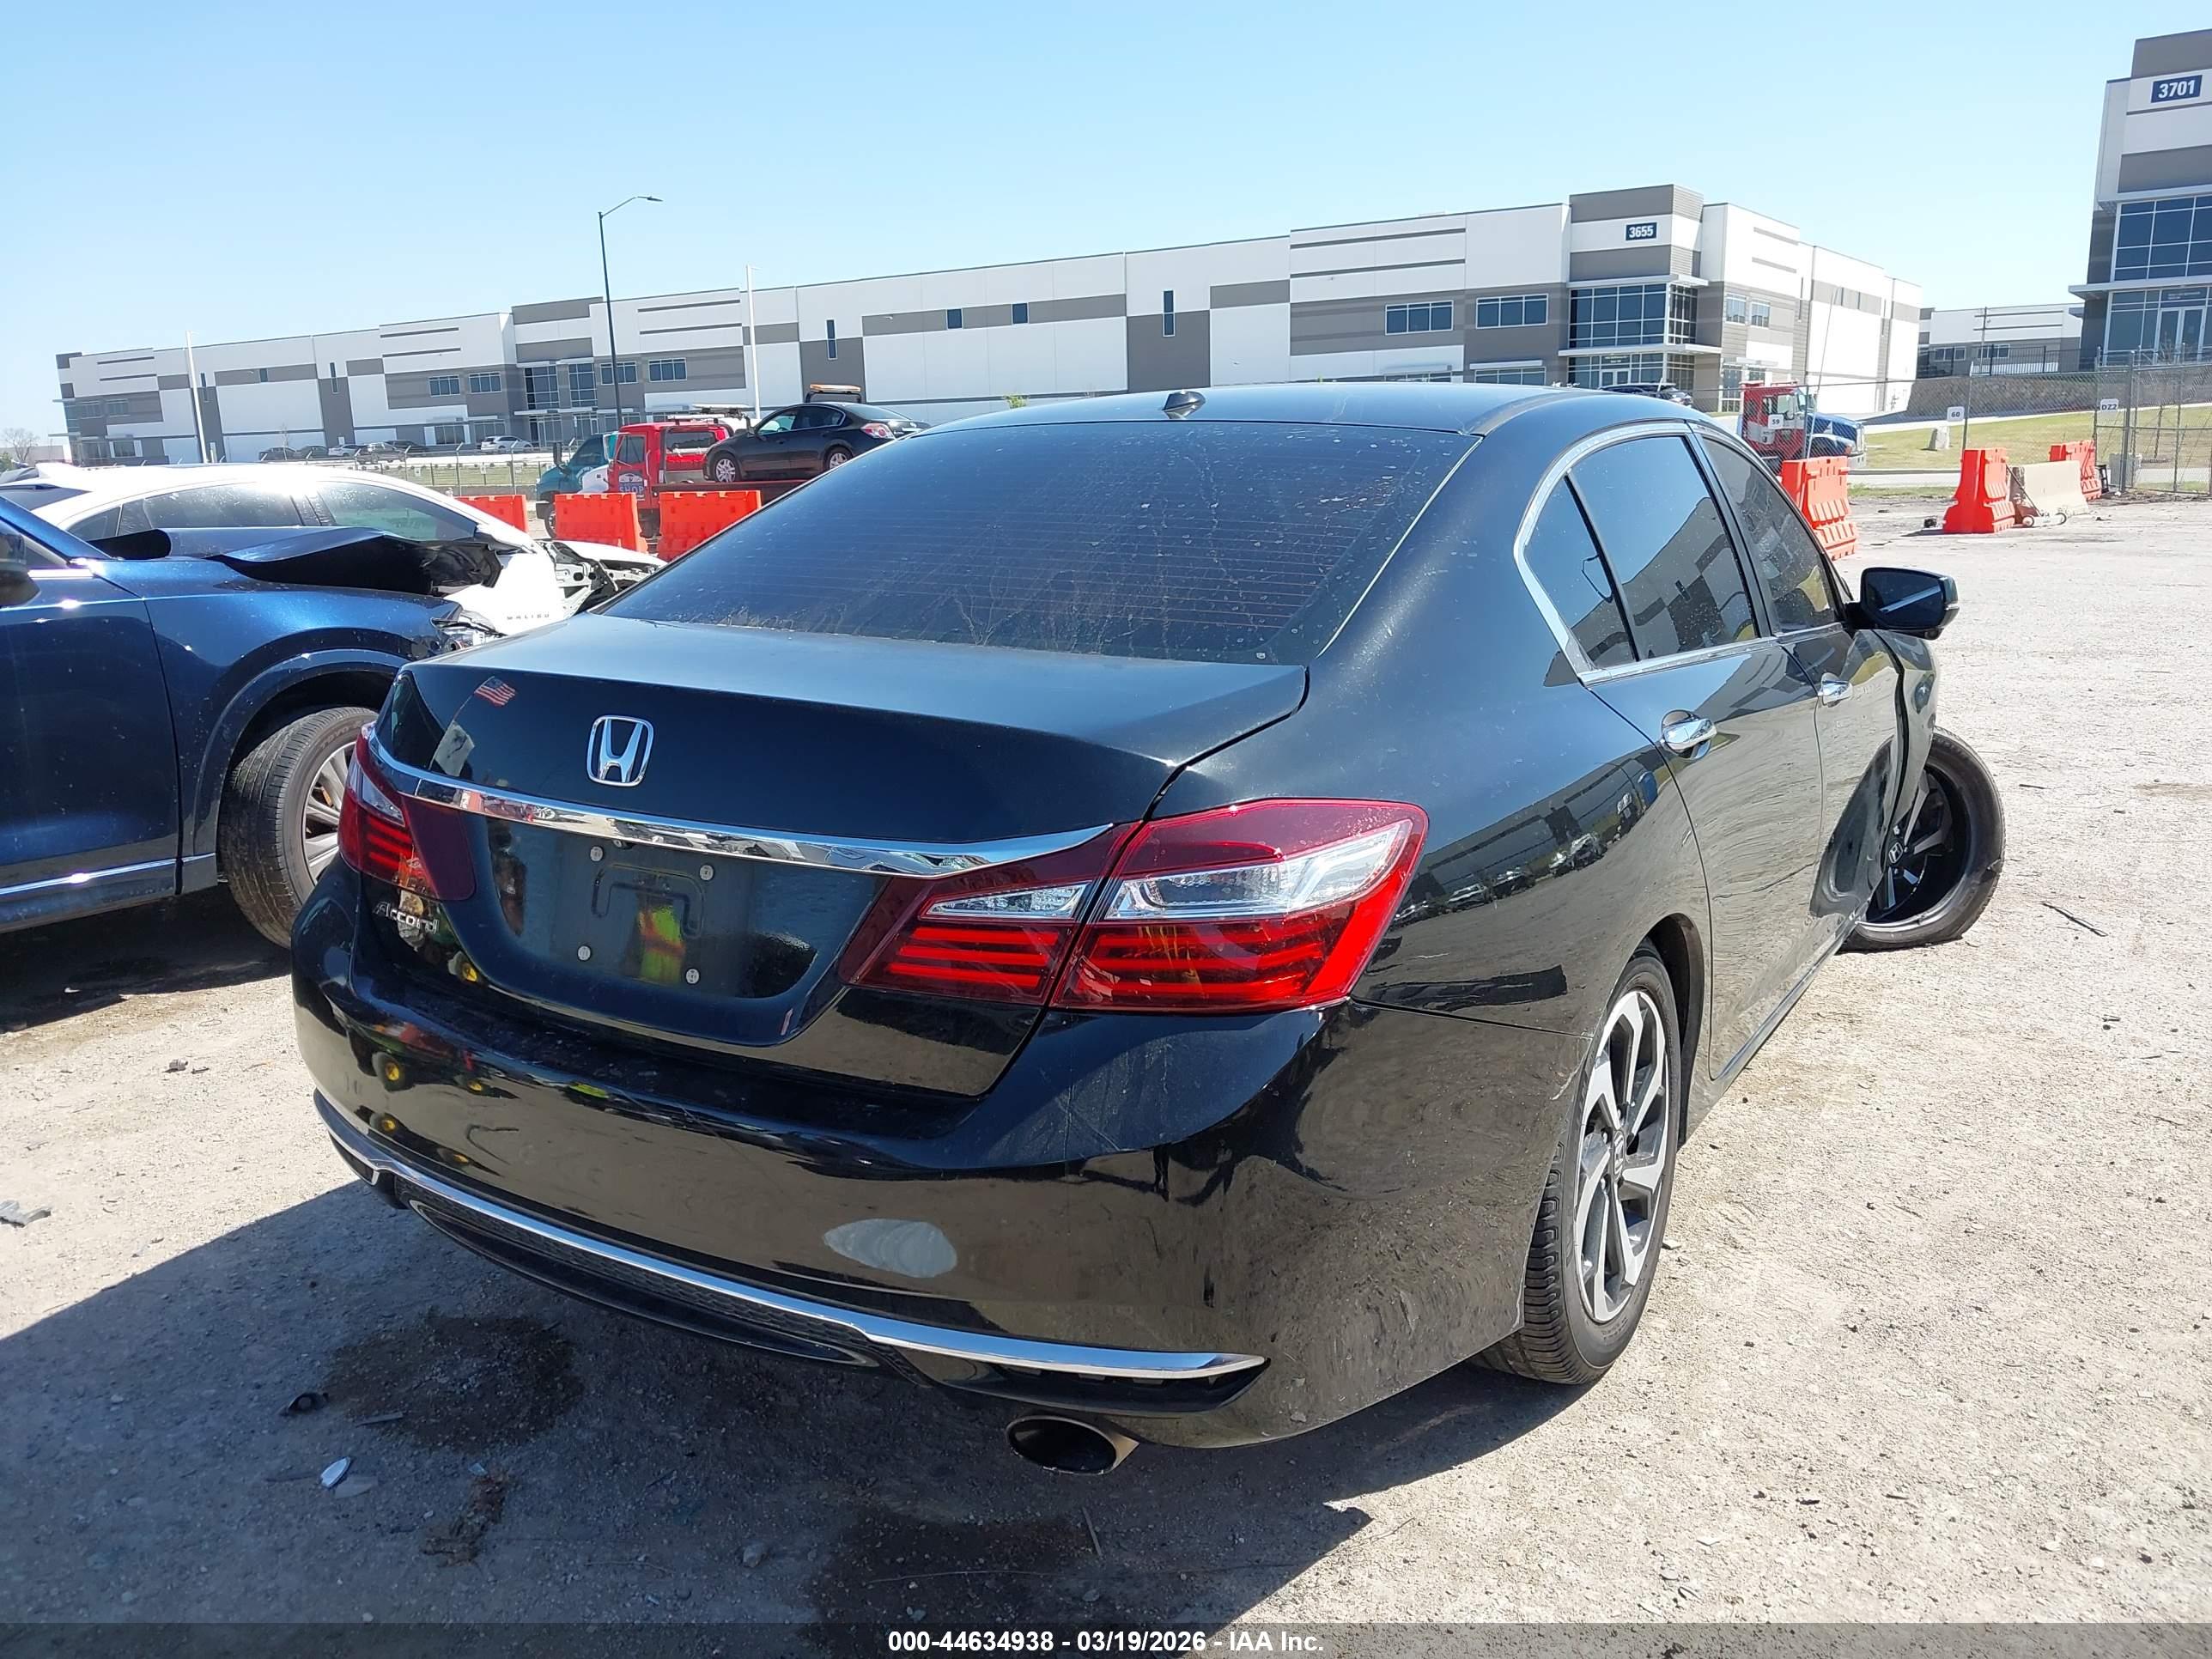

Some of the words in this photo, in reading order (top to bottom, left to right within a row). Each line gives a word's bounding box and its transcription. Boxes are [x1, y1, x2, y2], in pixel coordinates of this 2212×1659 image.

[2158, 79, 2196, 99] 3701
[1628, 225, 1654, 239] 3655
[619, 485, 644, 495] SHOP
[372, 901, 440, 934] Accord
